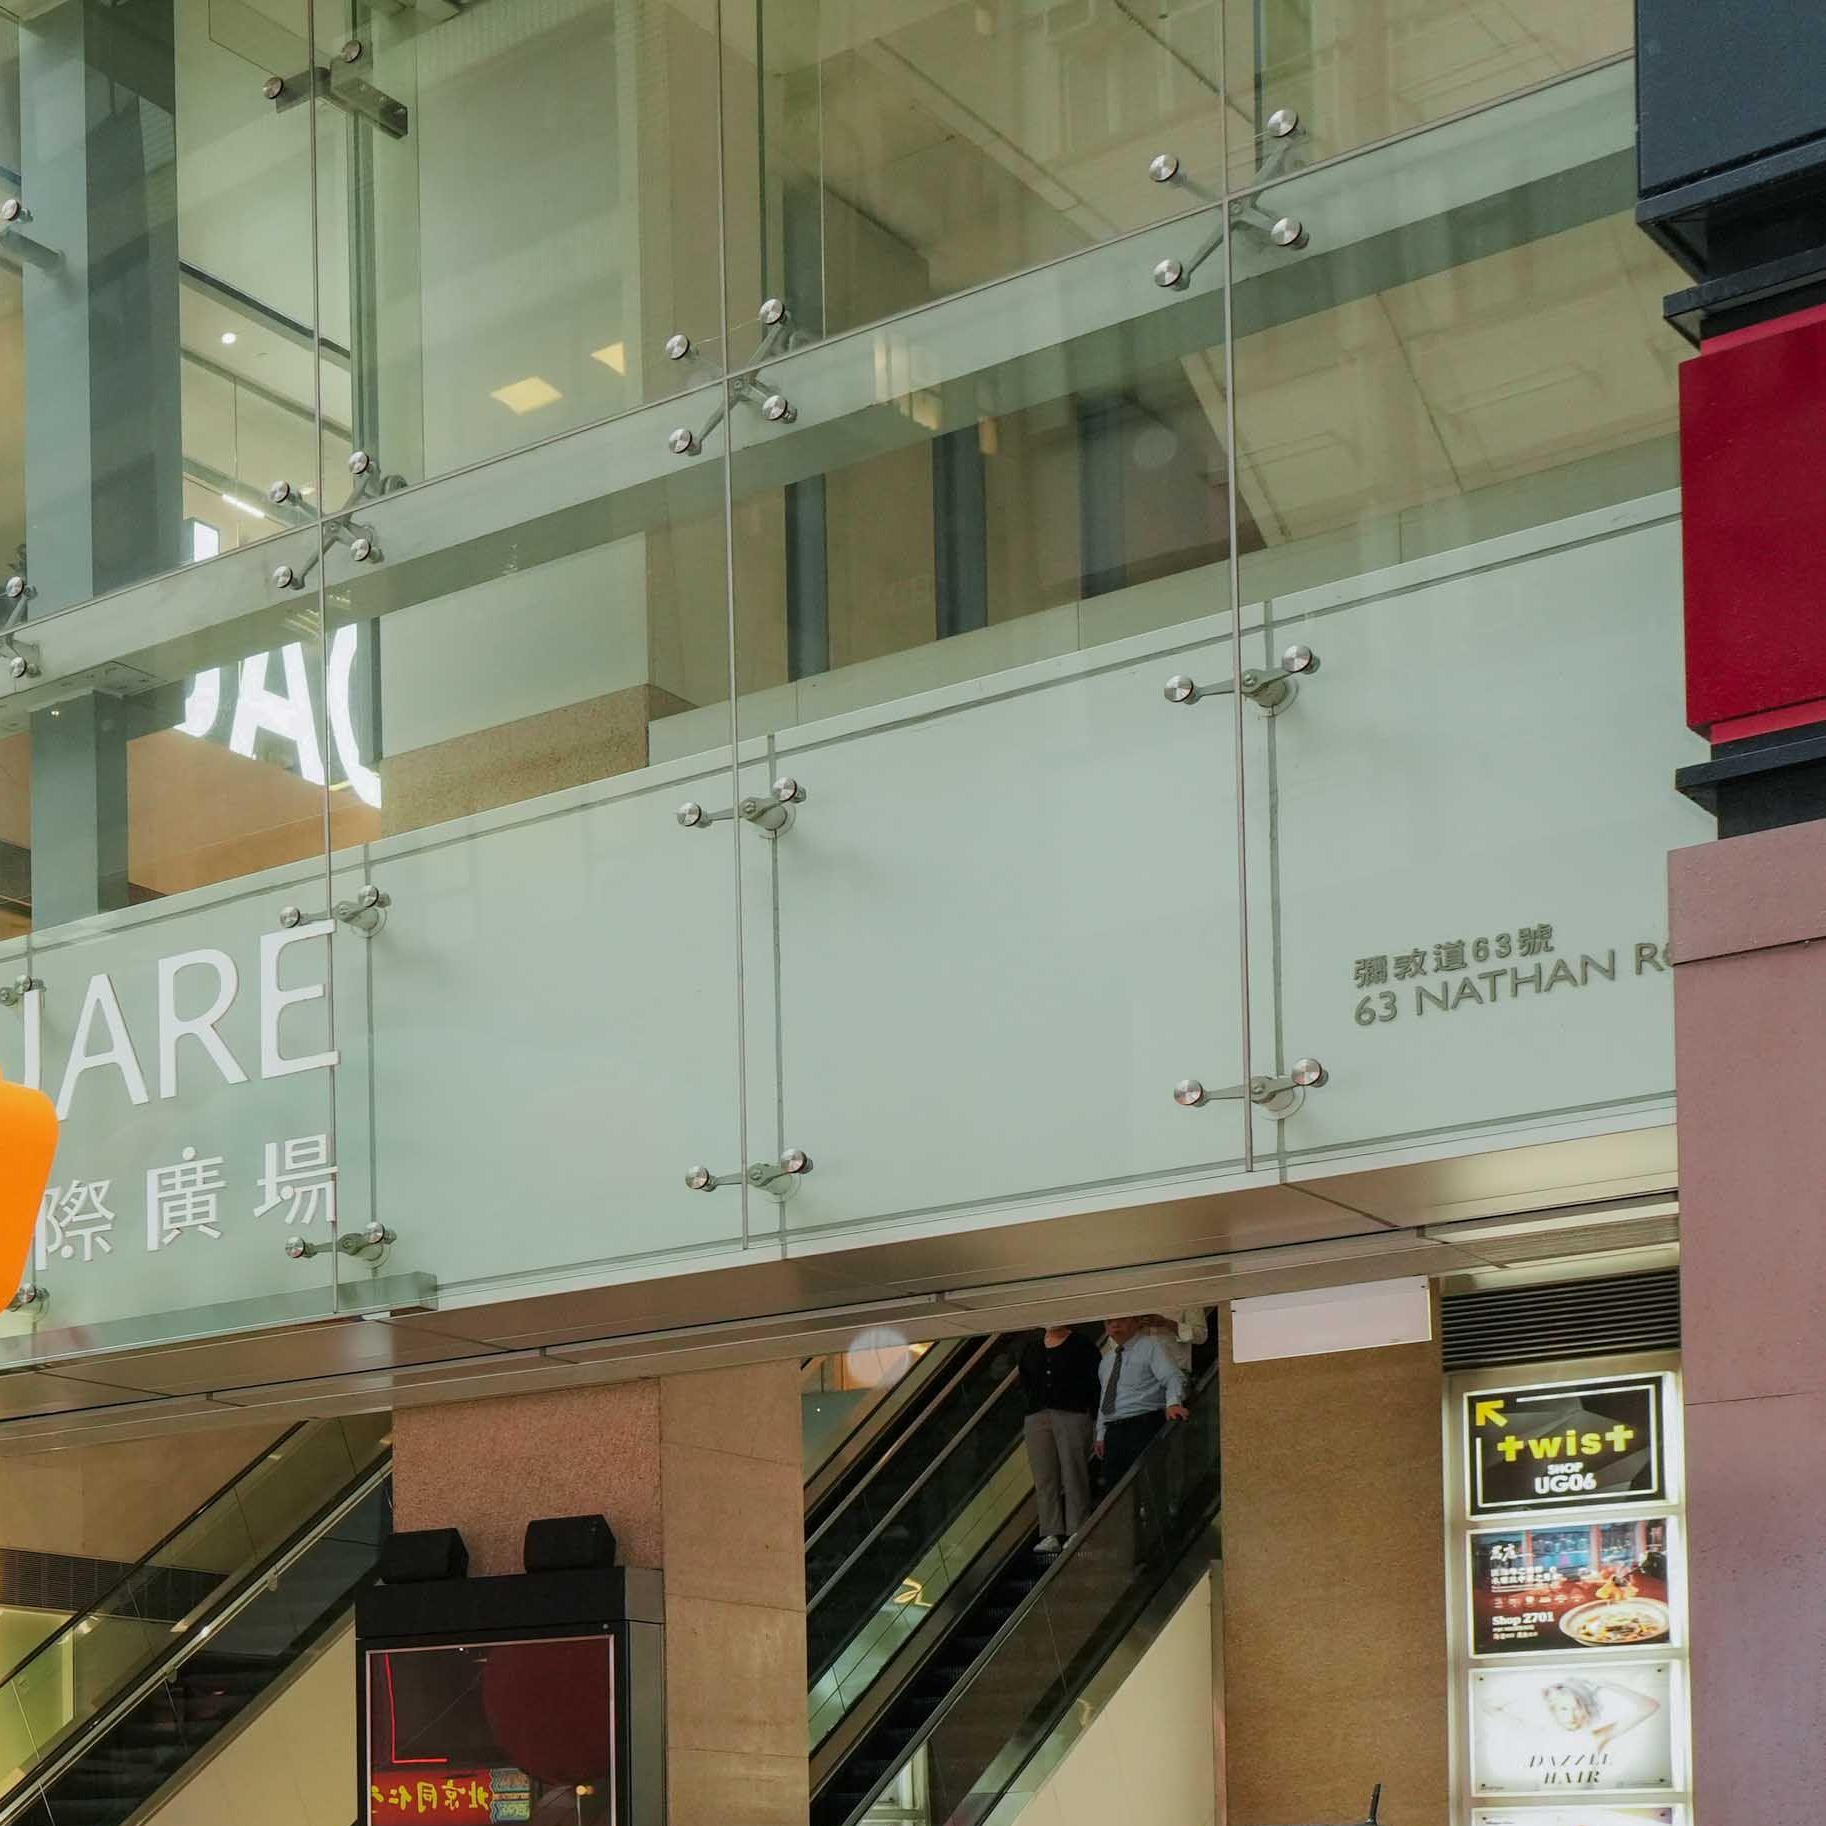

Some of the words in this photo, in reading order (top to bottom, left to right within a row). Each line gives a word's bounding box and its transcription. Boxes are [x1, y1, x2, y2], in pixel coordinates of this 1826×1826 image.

[1353, 922, 1555, 989] 彌敦道63號
[1354, 990, 1398, 1027] 63
[1415, 948, 1616, 1016] NATHAN
[1634, 942, 1670, 976] R
[35, 1133, 340, 1272] 際廣場
[1497, 1424, 1635, 1462] twist
[1534, 1473, 1598, 1495] UG06
[1547, 1461, 1585, 1476] SHOP
[1544, 1770, 1601, 1785] HAIR
